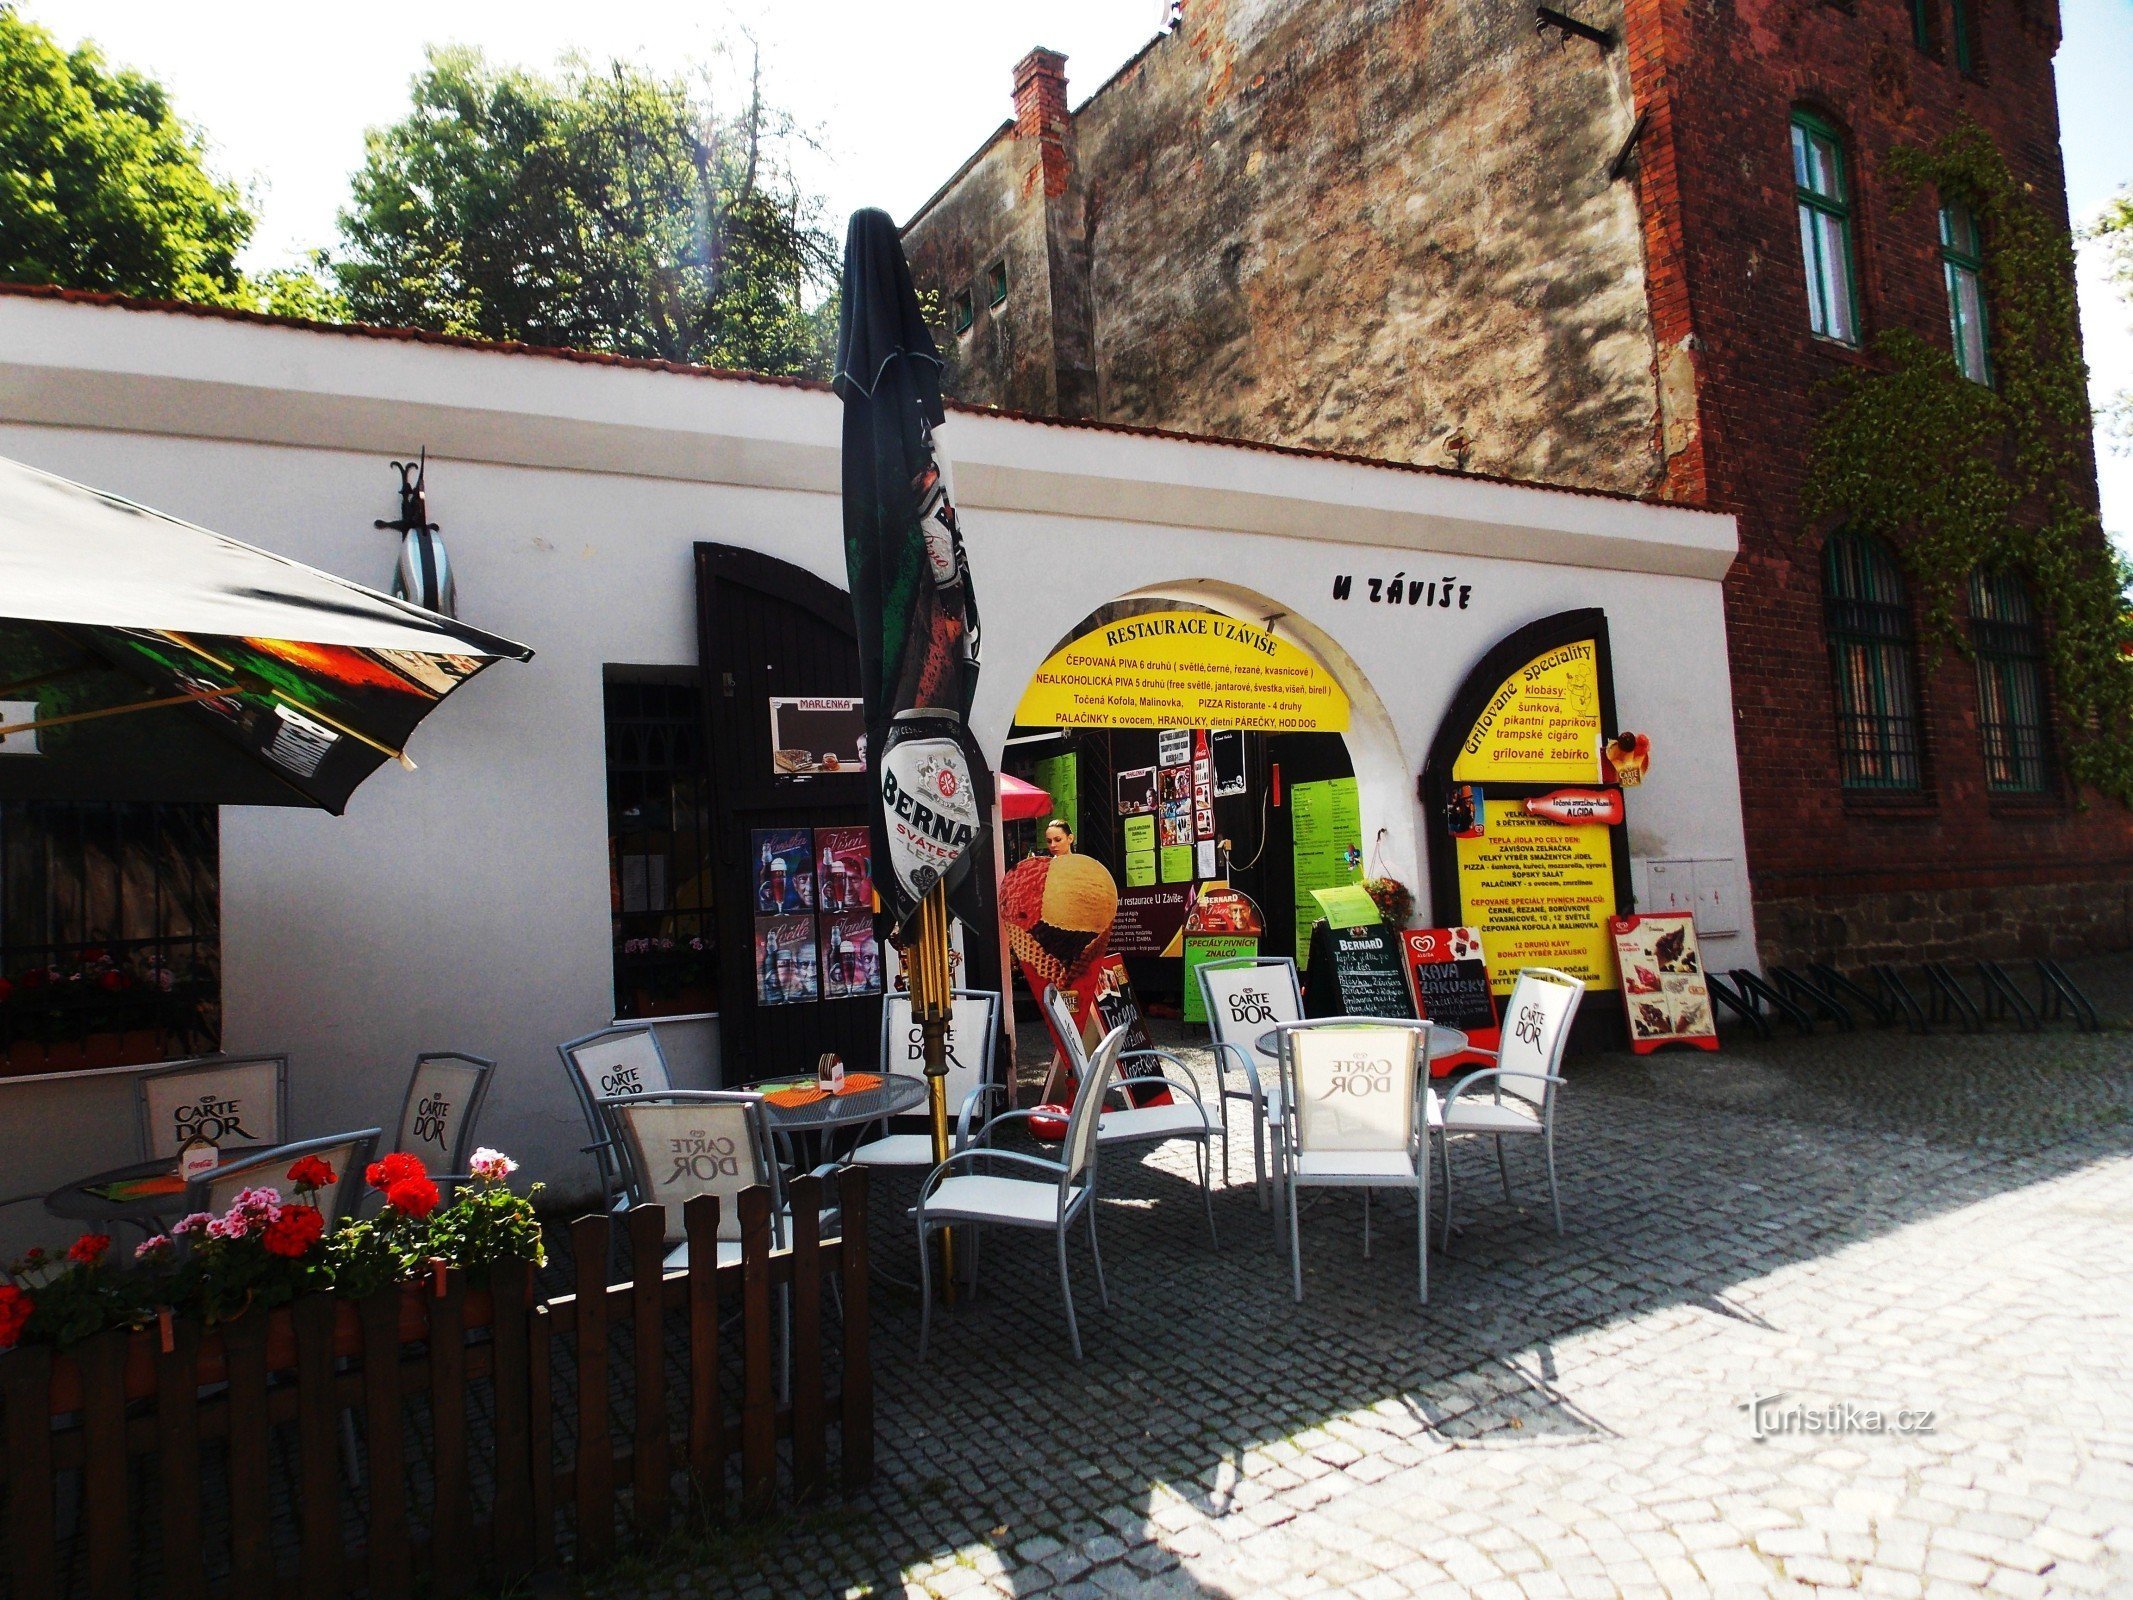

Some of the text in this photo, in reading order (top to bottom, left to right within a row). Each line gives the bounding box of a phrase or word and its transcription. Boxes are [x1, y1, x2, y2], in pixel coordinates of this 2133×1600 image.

[1332, 572, 1472, 609] U ZÁVIŠE
[1106, 618, 1208, 647] RESTAURACE
[1066, 653, 1117, 668] ČEPOVANÁ
[1118, 658, 1138, 669] PIVA
[1139, 660, 1145, 669] 6
[1146, 660, 1172, 671] druhů
[1234, 664, 1263, 675] řezané,
[1264, 666, 1309, 676] kvasnicové
[1036, 673, 1113, 687] NEALKOHOLICKÁ
[1115, 677, 1134, 688] PIVA
[1135, 678, 1140, 688] 5
[1141, 678, 1165, 689] druhů
[1166, 680, 1185, 691] (free
[1187, 681, 1213, 691] světlé,
[1214, 682, 1253, 693] jantarové,
[1308, 686, 1327, 695] birell
[1525, 685, 1567, 697] klobásy:
[800, 699, 850, 709] MARLENKA
[1073, 694, 1302, 713] Točená Kofola, Malinovka, PIZZA Ristorante 4 druhy
[1464, 645, 1591, 755] Grilované speciality
[1517, 702, 1563, 715] šunková,
[1055, 711, 1317, 729] PALAČINKY s ovocem, HRANOLKY, dietní PÁREČKY, HOD DOG
[1503, 715, 1597, 729] pikantní papriková
[1496, 729, 1579, 742] trampské cigáro
[1492, 748, 1590, 760] grilované žebírko
[1619, 770, 1639, 779] CARTE
[882, 766, 976, 848] BERNA
[896, 823, 959, 859] SVÁTEČ
[906, 844, 949, 868] LEŽÁ
[1481, 880, 1522, 888] PALAČINKY
[1124, 896, 1154, 906] restaurace
[1154, 894, 1161, 904] U
[1204, 894, 1239, 904] BERNARD
[1187, 937, 1256, 947] SPECIÁLY PIVNÍCH
[1338, 938, 1384, 951] BERNARD
[1206, 948, 1237, 957] ZNALCŮ
[1229, 992, 1270, 1008] CARTE
[1231, 1005, 1279, 1024] D'OR
[1520, 1005, 1546, 1025] CARTE
[601, 1067, 639, 1092] CARTE
[174, 1099, 242, 1123] CARTE
[418, 1098, 451, 1118] CARTE
[174, 1116, 260, 1142] D'OR
[413, 1116, 448, 1152] D'OR
